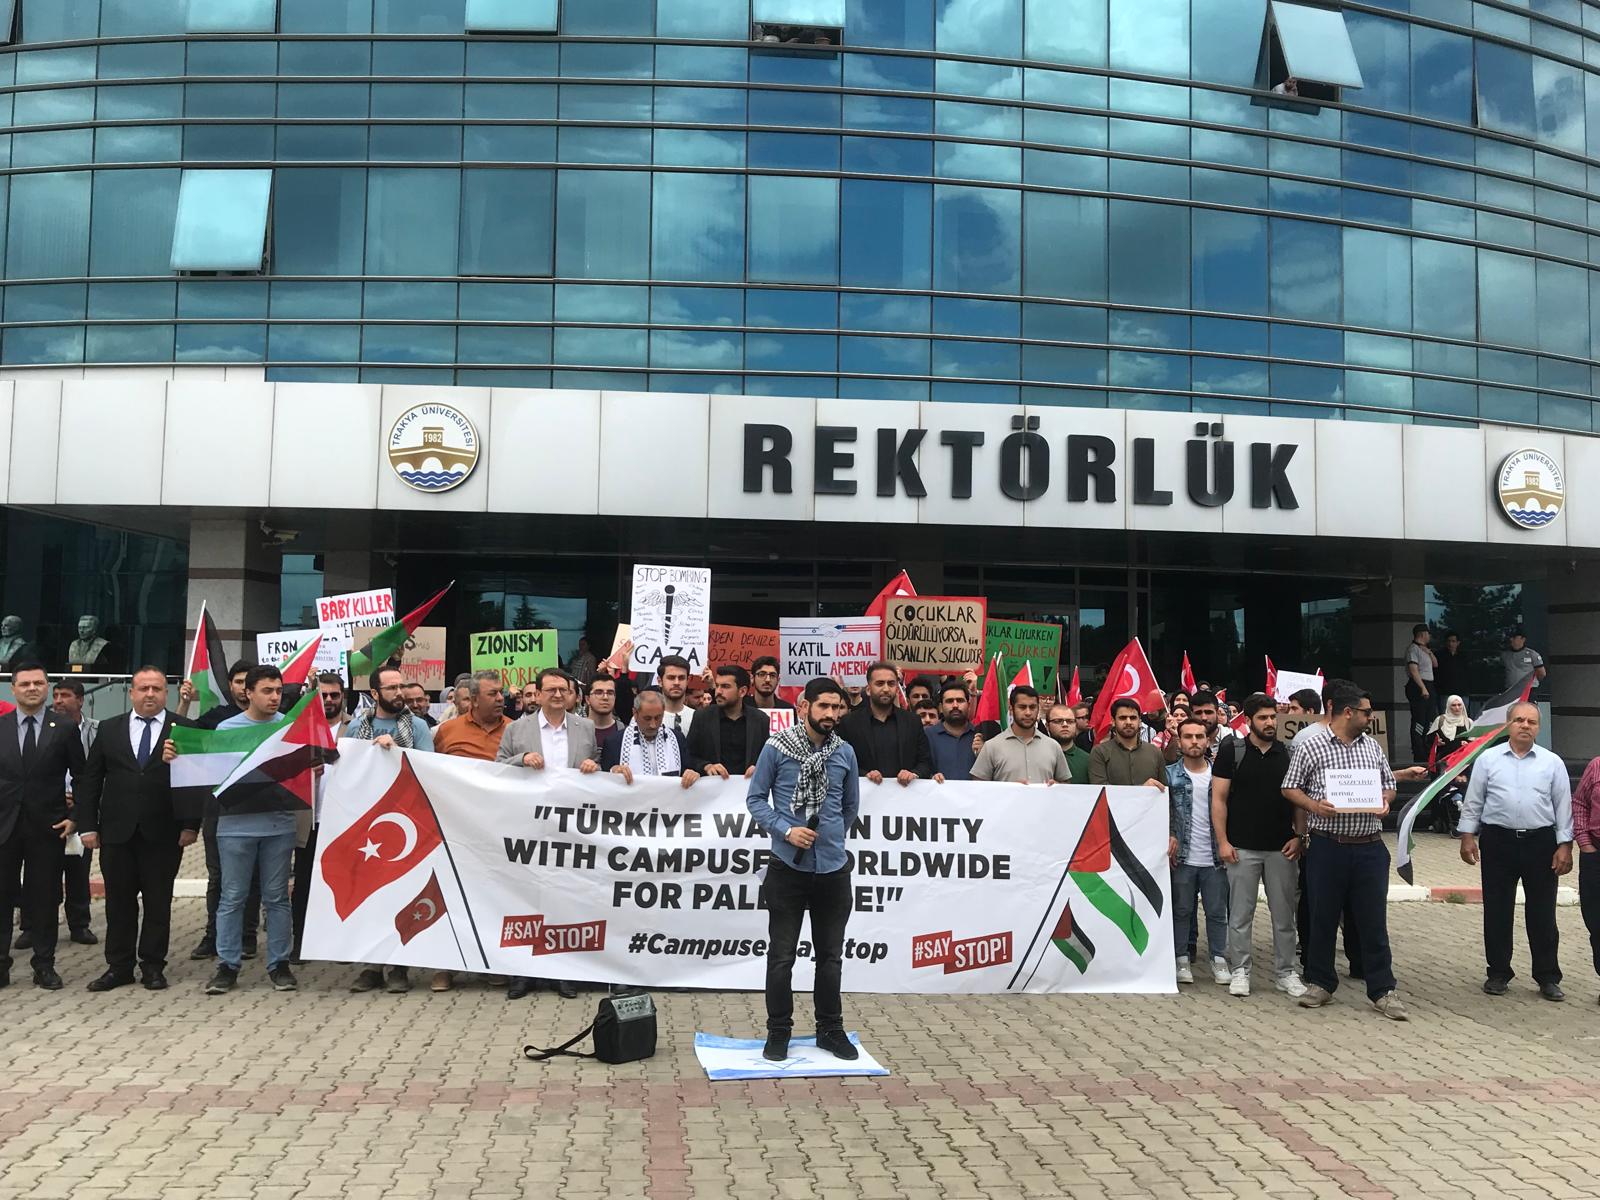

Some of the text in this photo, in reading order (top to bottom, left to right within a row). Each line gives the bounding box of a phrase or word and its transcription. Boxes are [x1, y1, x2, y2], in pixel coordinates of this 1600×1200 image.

[392, 405, 474, 447] TRAKYA ÜNİVERSİTESİ
[424, 433, 442, 443] 1982
[743, 415, 1299, 509] REKTÖRLÜK
[1503, 457, 1521, 487] TRAKYA
[637, 567, 707, 583] STOP BOMBING
[320, 594, 394, 622] BABY KILLER
[476, 632, 544, 655] ZIONISM
[634, 644, 700, 666] GAZA
[788, 641, 877, 657] KATİL İSRAİL
[504, 656, 514, 666] IS
[788, 660, 871, 676] KATİL AMERİK
[534, 803, 702, 838] "TÜRKİYE
[882, 815, 984, 843] UNITY
[503, 837, 597, 869] WITH
[607, 846, 770, 874] CAMPUSE
[612, 881, 682, 909] FOR
[503, 920, 600, 951] #SAY STOP!
[915, 936, 1007, 968] #SAY STOP!
